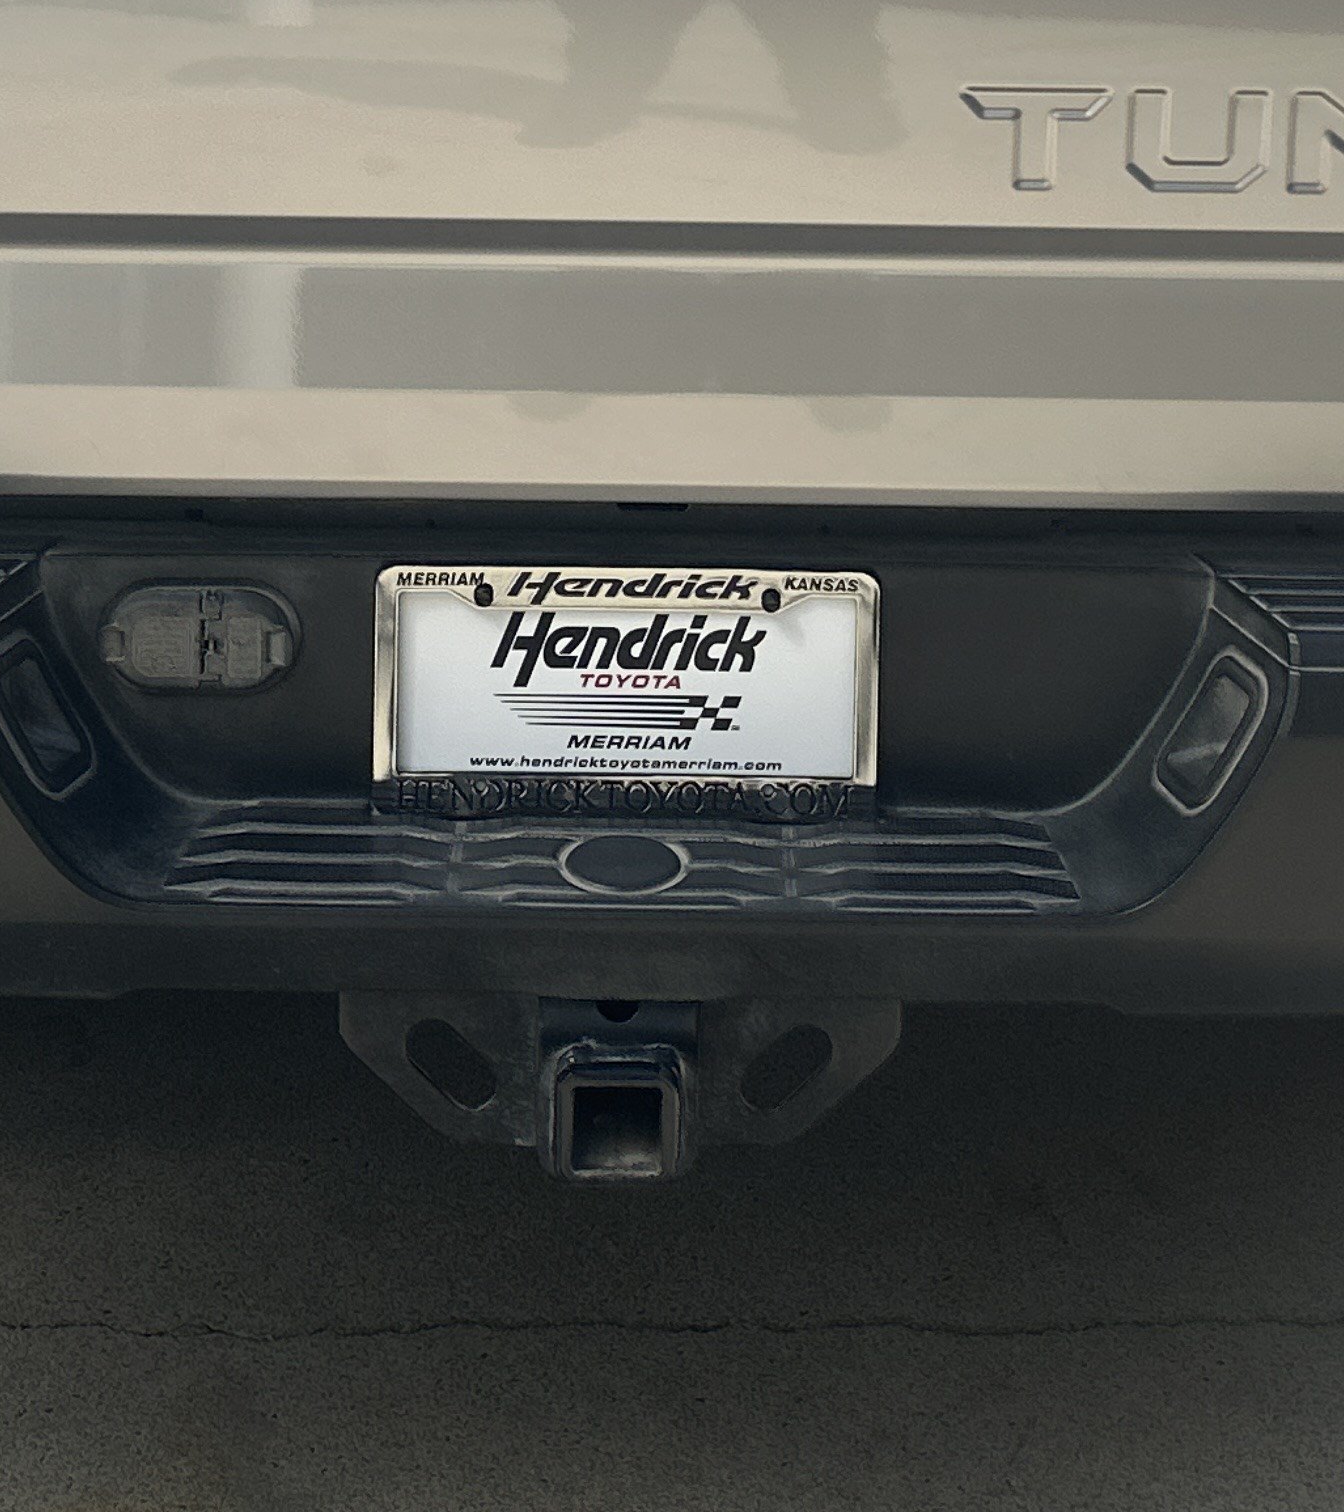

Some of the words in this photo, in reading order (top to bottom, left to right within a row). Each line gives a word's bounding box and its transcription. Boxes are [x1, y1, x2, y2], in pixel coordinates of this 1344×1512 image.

[397, 572, 485, 587] MERRIAM
[784, 576, 859, 592] KANSAS
[507, 572, 759, 606] Hendrick
[490, 611, 767, 688] Hendrick
[580, 674, 682, 689] TOYOTA
[567, 734, 692, 751] MERRIAM
[470, 754, 783, 772] www.hendricktoyotamerriam.com
